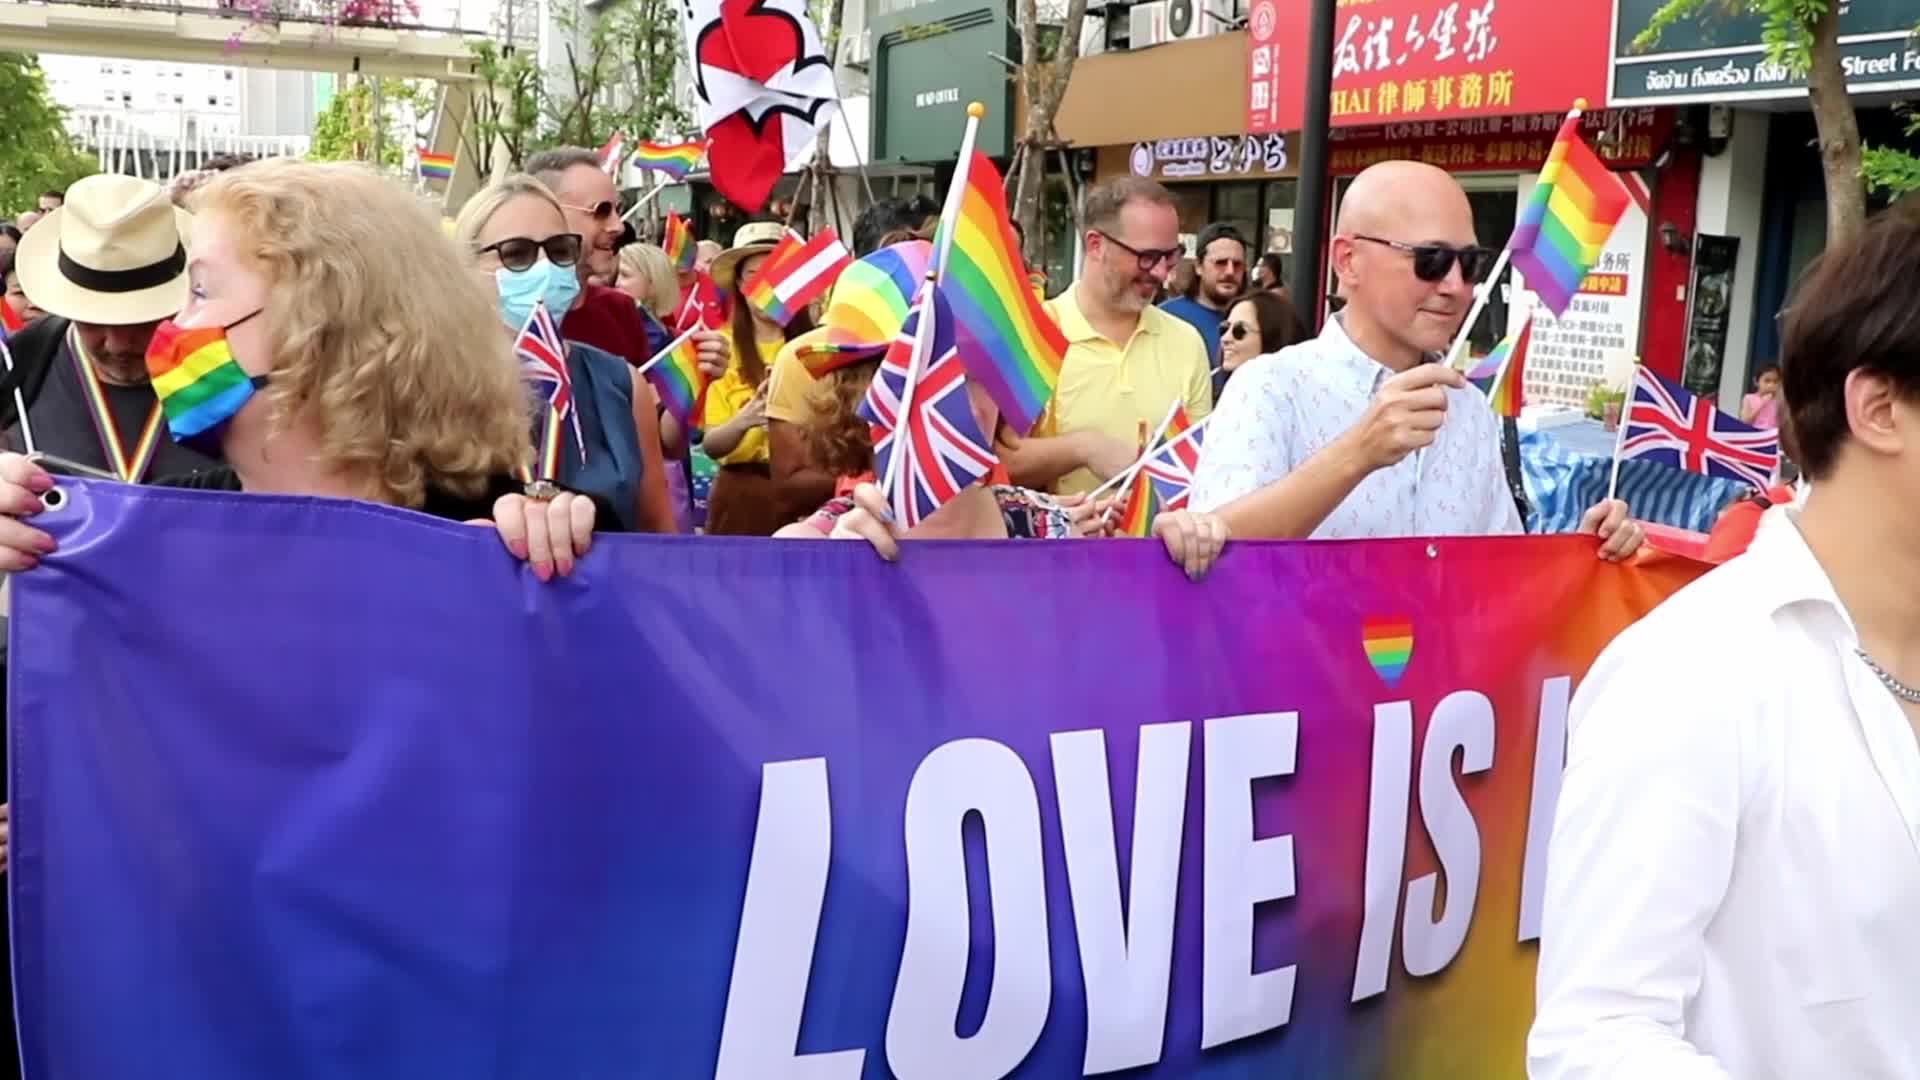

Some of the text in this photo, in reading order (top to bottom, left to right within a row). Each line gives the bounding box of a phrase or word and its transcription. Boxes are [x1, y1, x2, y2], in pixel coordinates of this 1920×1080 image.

[1841, 52, 1898, 76] Street
[1377, 70, 1514, 115] 律師事務所
[714, 711, 1299, 1080] LOVE
[1351, 690, 1496, 1003] IS
